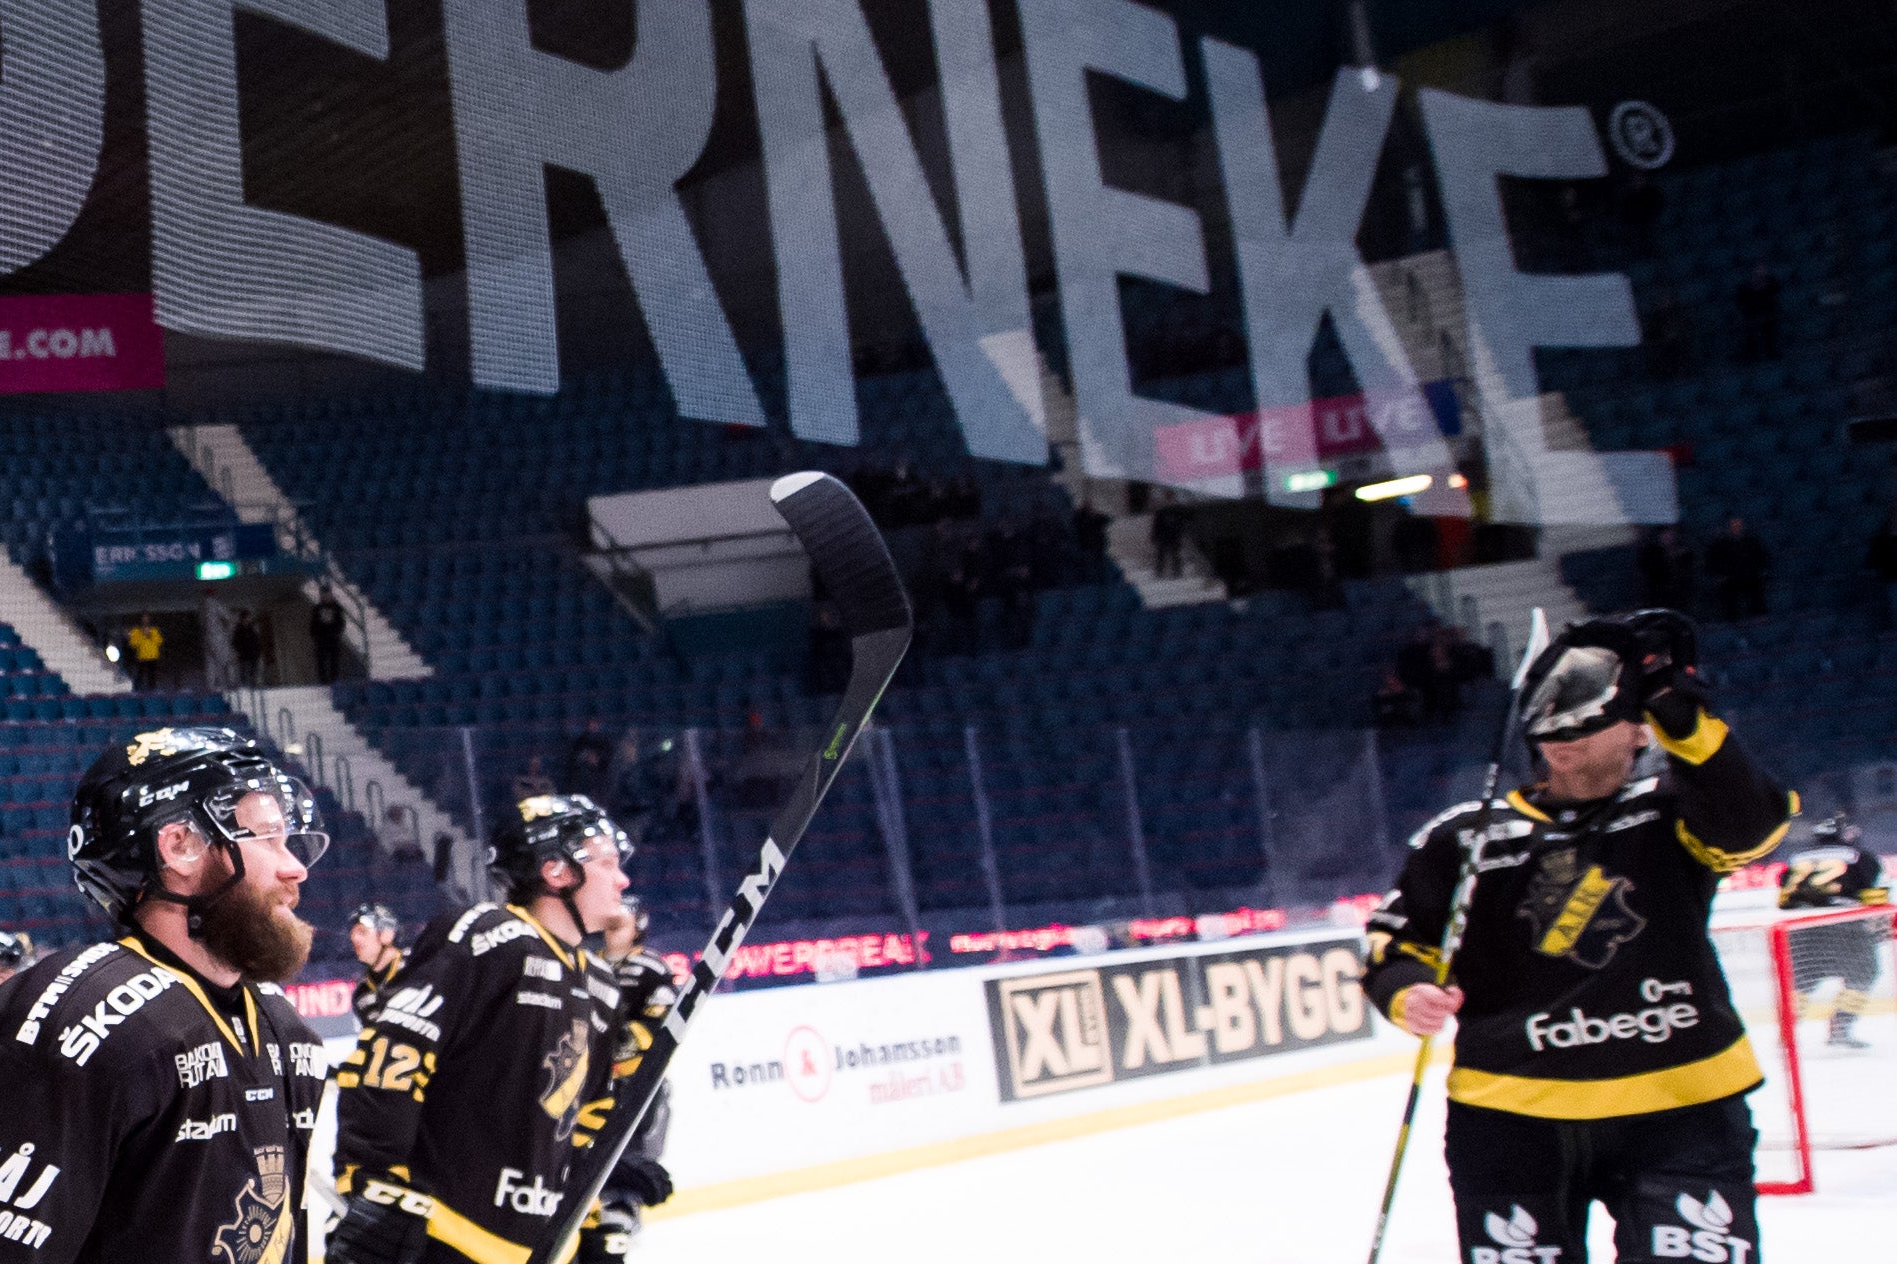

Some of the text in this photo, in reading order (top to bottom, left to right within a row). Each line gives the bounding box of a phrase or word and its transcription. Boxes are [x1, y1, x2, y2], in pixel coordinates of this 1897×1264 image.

[660, 837, 787, 1046] CCM
[58, 966, 184, 1068] ŠKODA
[1112, 948, 1366, 1070] XL-BYGG
[1525, 1003, 1700, 1051] Fabege
[363, 1037, 422, 1092] 12
[835, 1035, 961, 1072] Johansson
